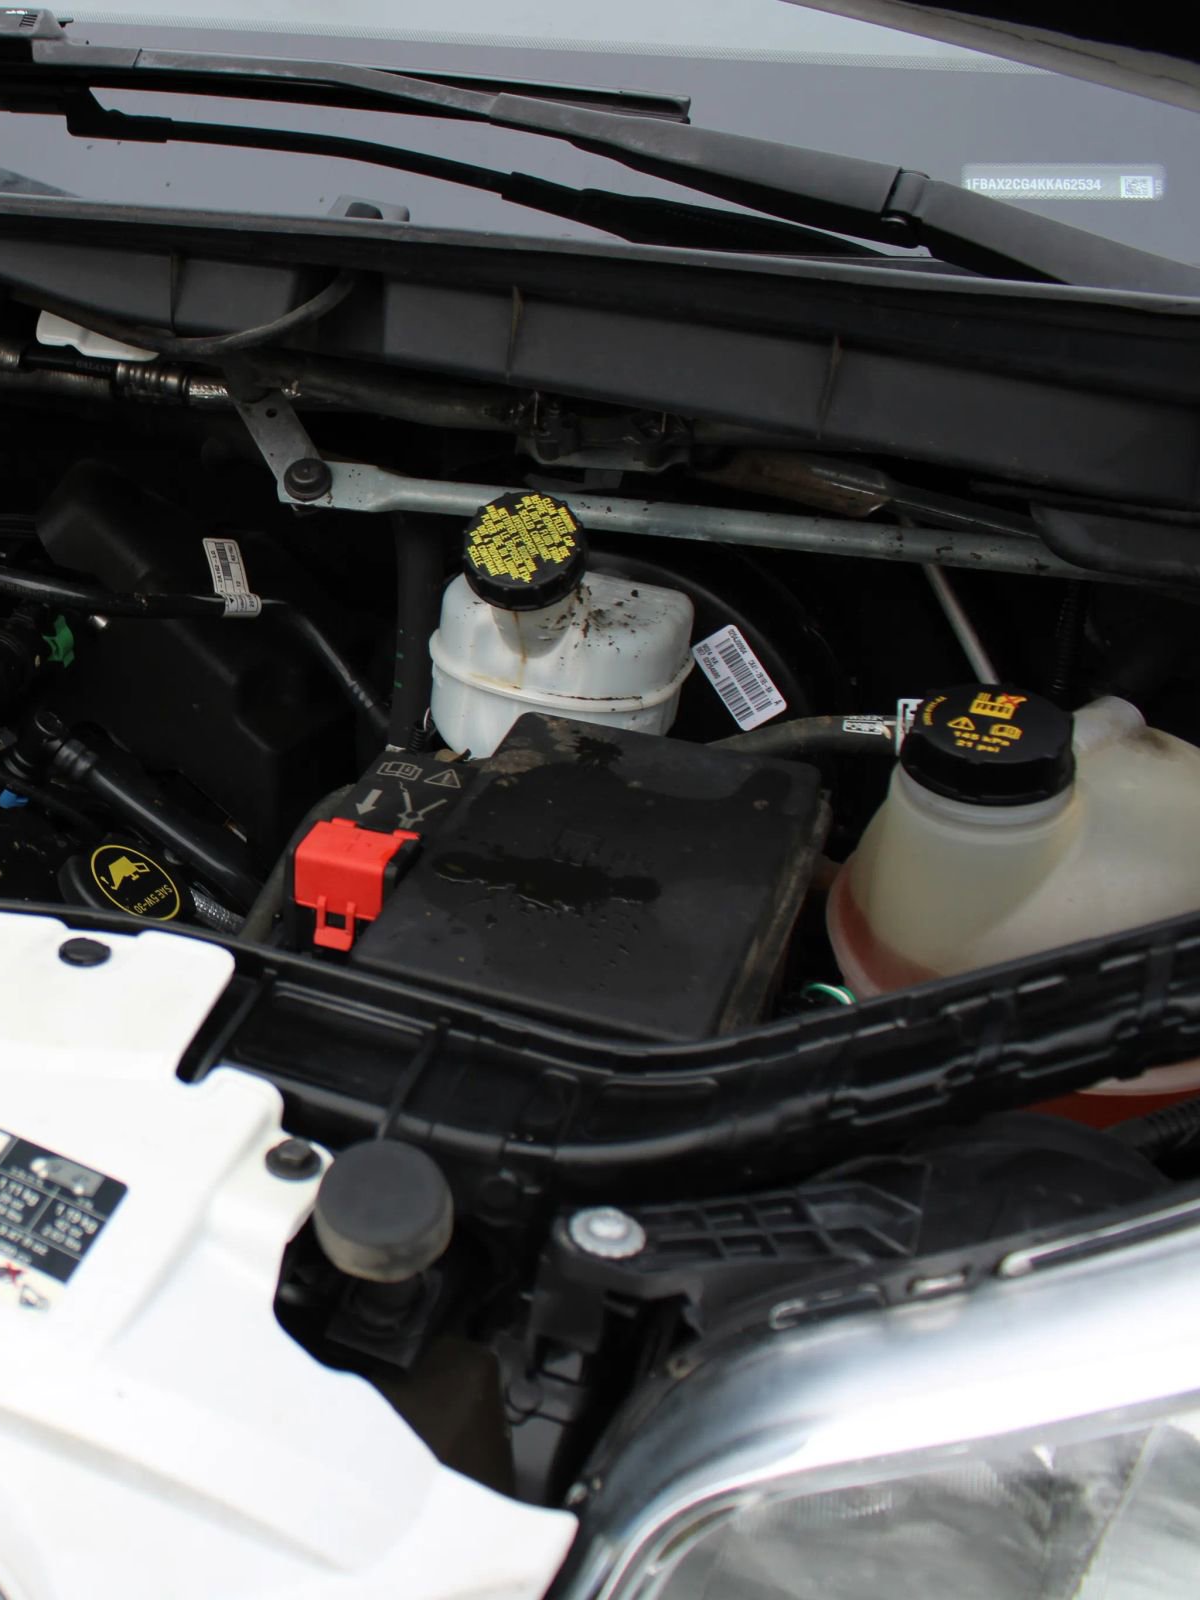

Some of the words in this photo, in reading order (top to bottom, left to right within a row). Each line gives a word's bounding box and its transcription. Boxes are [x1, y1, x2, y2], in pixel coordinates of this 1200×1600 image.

[519, 509, 535, 529] SEALED
[512, 536, 522, 545] LE
[551, 516, 568, 535] FILLER
[562, 536, 575, 546] CAP
[975, 744, 1000, 752] psi
[982, 735, 1010, 746] kPa
[155, 884, 173, 899] SAE
[134, 893, 160, 914] 5W-30
[21, 1188, 40, 1207] kg
[77, 1215, 98, 1235] kg
